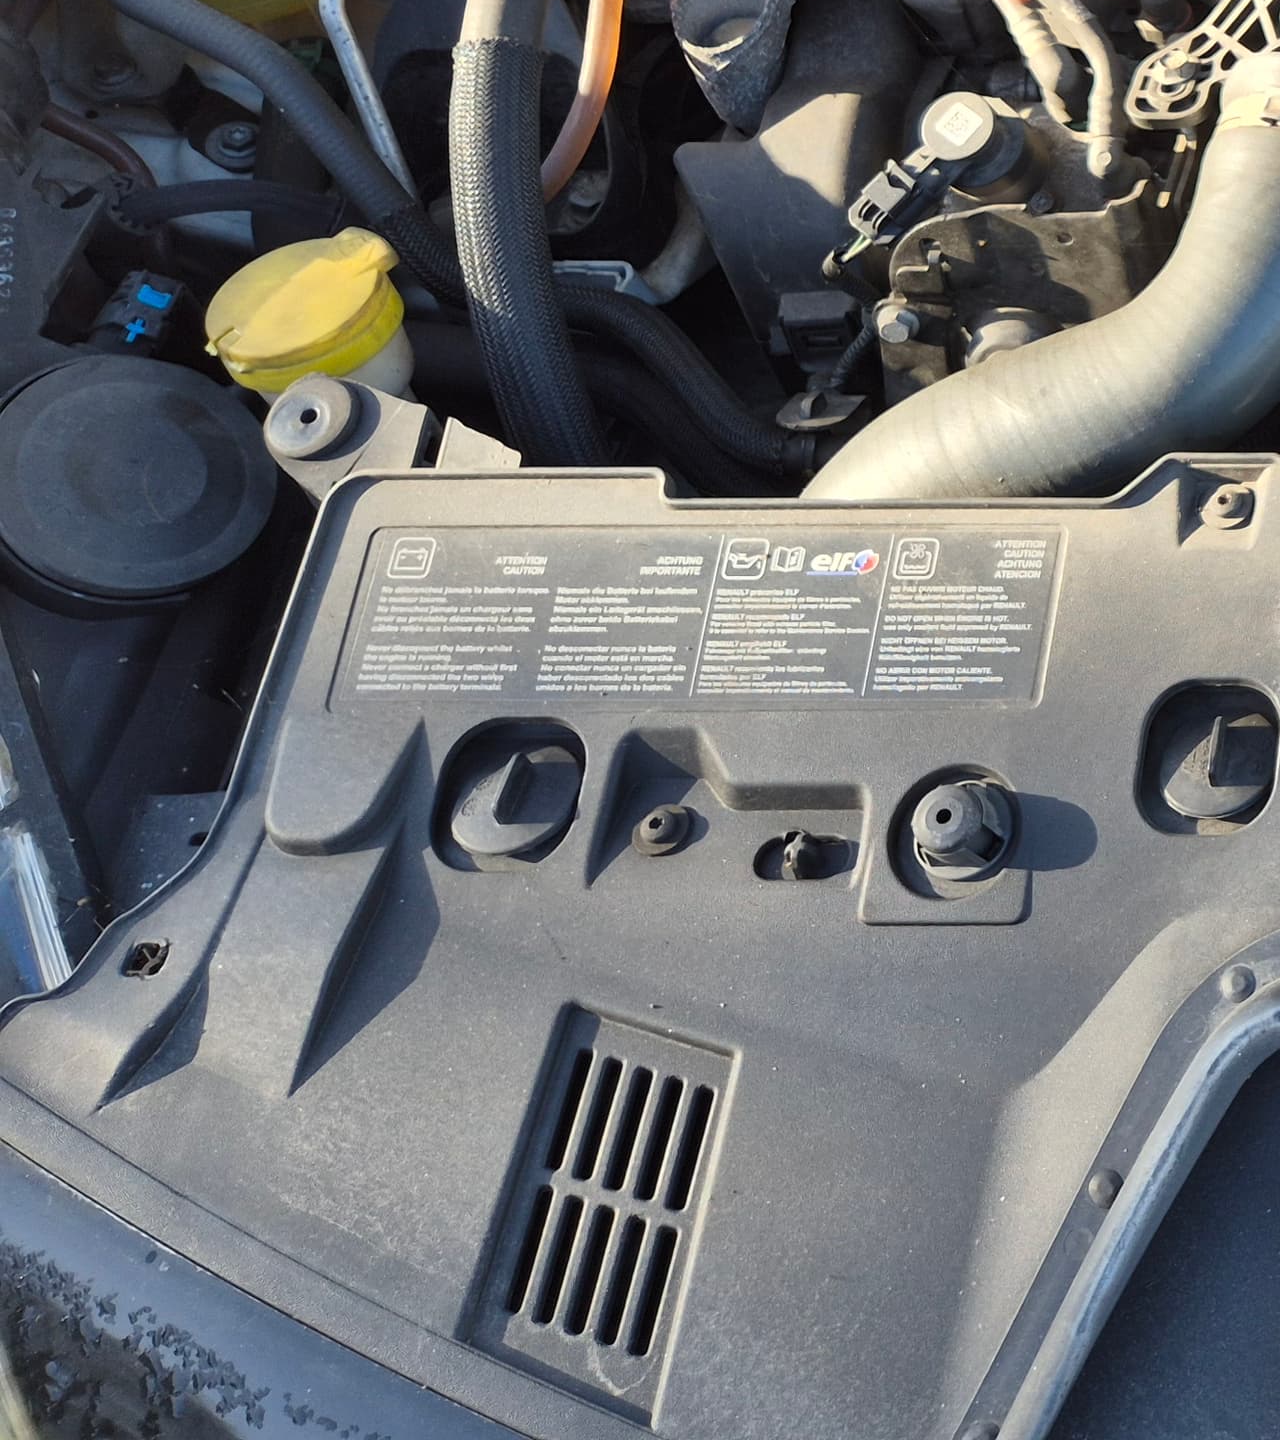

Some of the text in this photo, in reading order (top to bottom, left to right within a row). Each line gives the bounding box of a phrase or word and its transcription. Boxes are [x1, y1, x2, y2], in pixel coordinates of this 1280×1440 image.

[1004, 550, 1045, 558] CAUTION
[495, 556, 547, 565] ATTENTION
[656, 556, 703, 565] ACHTUNG
[811, 553, 855, 571] elf
[997, 560, 1042, 568] ACHTUNG
[503, 567, 545, 575] CAUTION
[995, 570, 1041, 578] ATENCION
